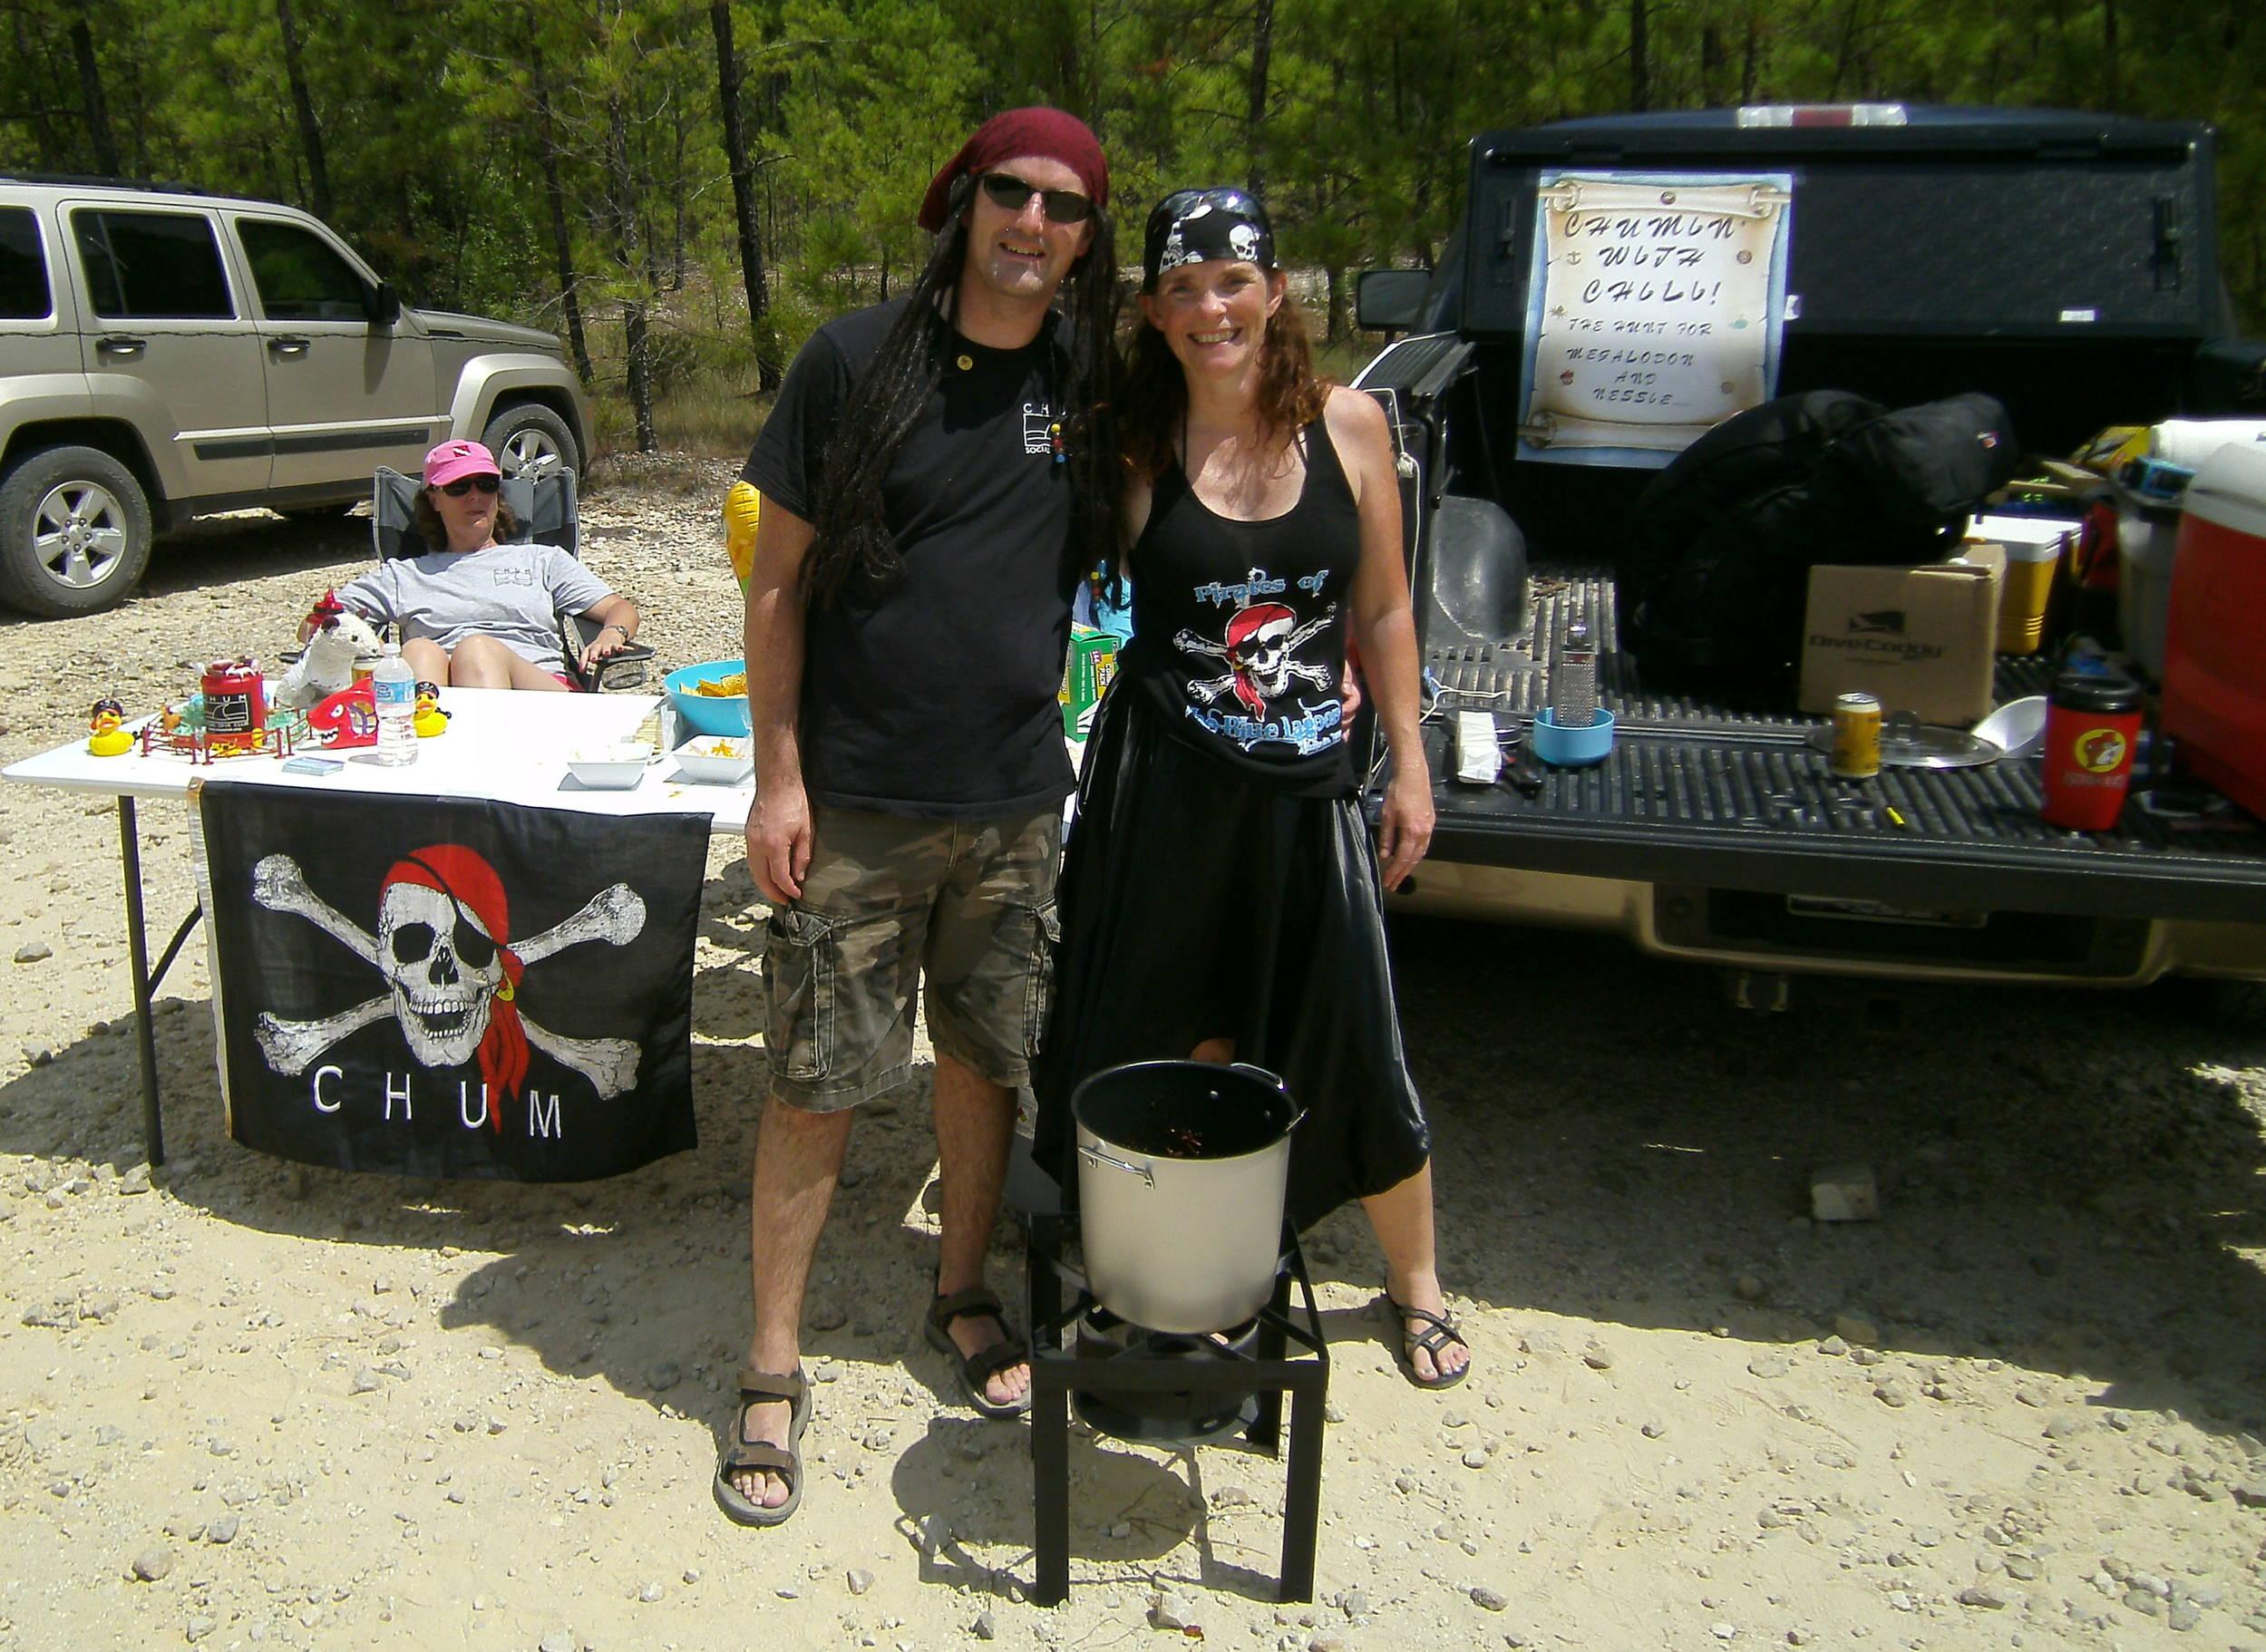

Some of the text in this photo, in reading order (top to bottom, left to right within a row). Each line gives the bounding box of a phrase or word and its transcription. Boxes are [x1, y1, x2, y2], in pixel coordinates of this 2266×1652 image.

[1598, 245, 1705, 268] WITH
[1582, 278, 1724, 305] CHILI!
[1569, 317, 1713, 335] THE HUNT FOR
[1566, 346, 1695, 367] MEGALODON
[1614, 370, 1658, 385] AND
[1297, 569, 1329, 598] of
[1222, 714, 1279, 743] Blue
[313, 1064, 561, 1140] CHUM
